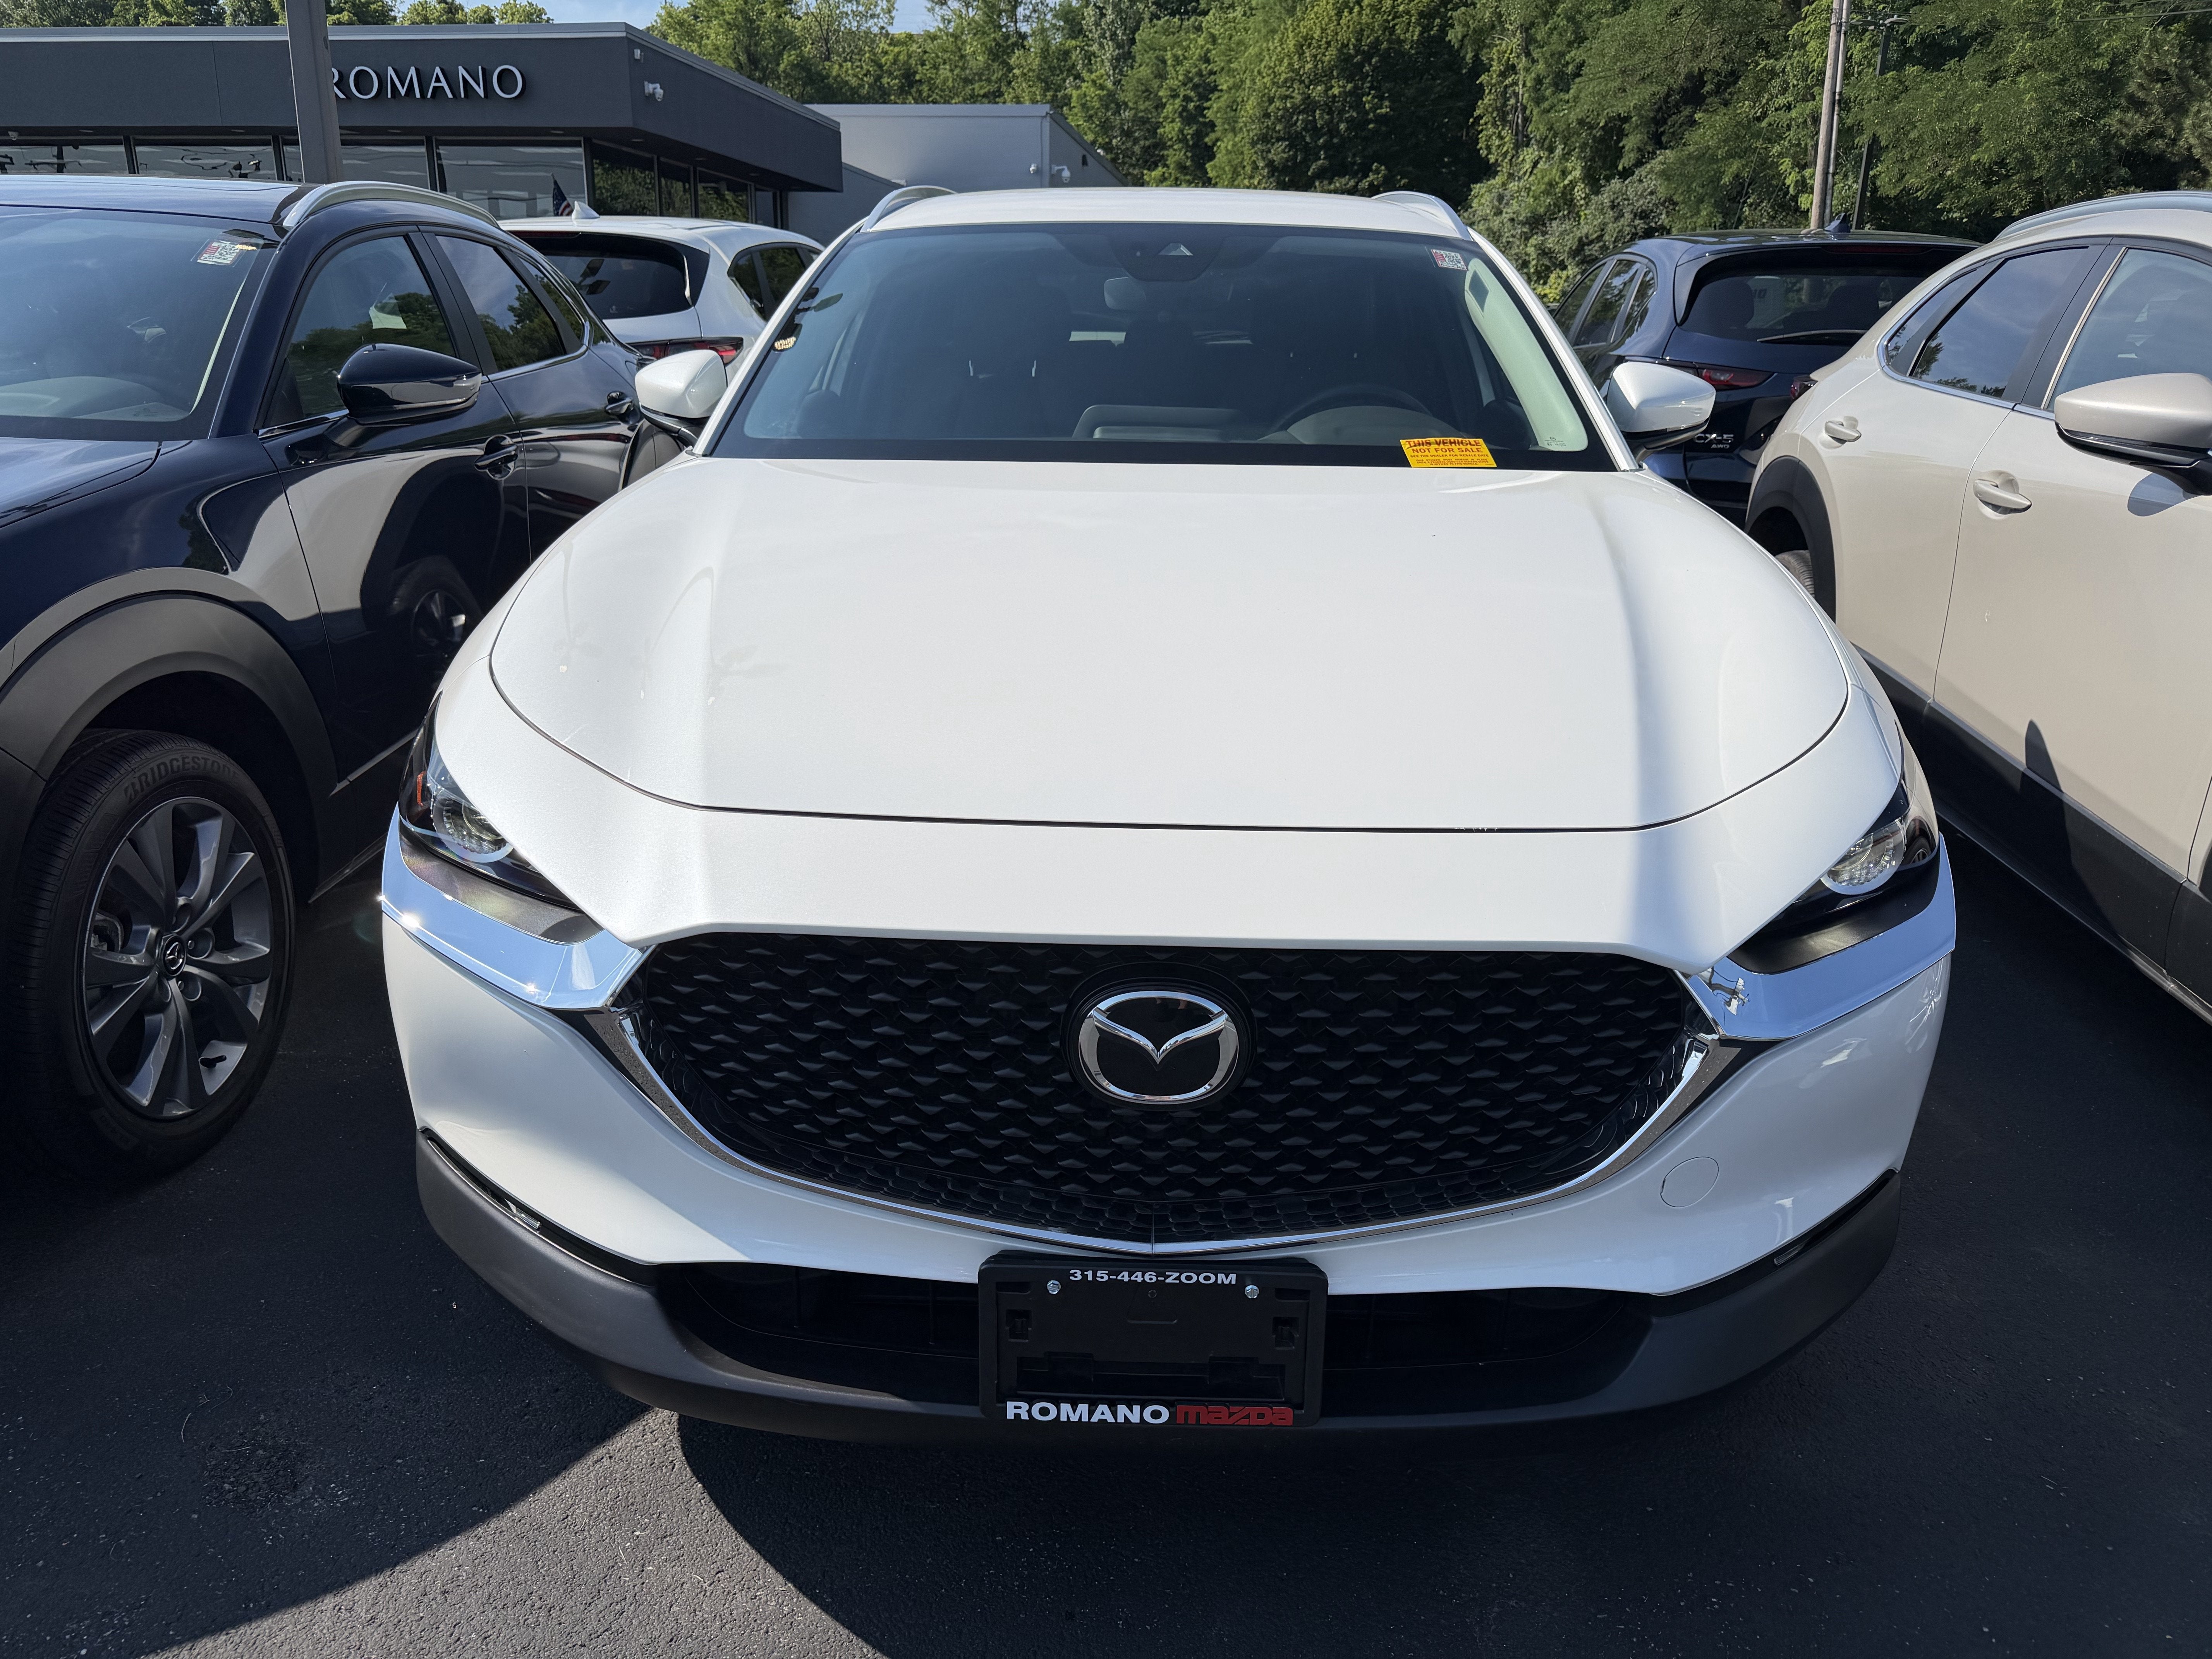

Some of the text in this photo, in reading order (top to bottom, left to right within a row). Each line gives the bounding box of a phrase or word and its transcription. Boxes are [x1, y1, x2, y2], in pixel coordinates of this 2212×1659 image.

[1695, 433, 1734, 443] CX-5
[1069, 1269, 1237, 1285] 315-446-ZOOM
[1006, 1401, 1170, 1424] ROMANO
